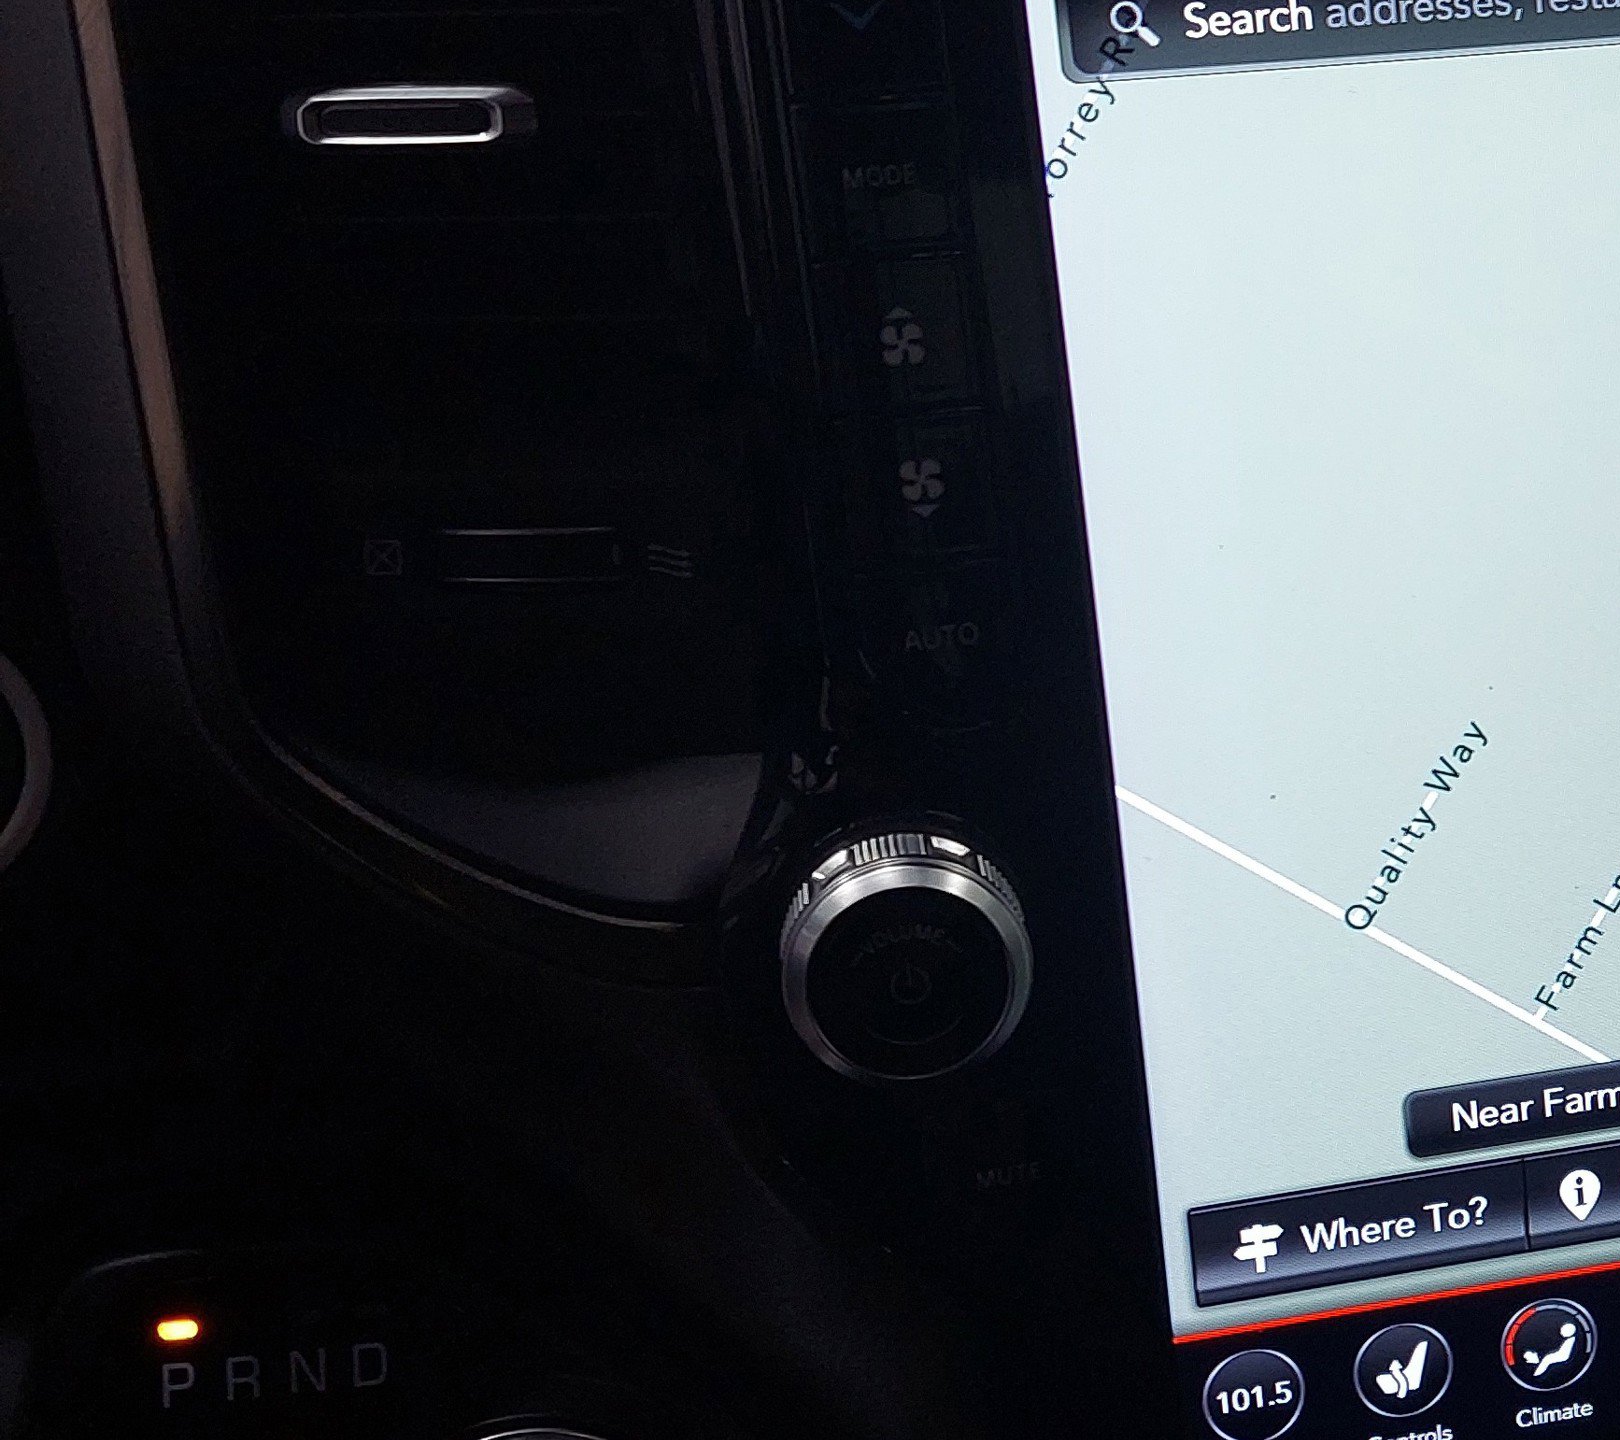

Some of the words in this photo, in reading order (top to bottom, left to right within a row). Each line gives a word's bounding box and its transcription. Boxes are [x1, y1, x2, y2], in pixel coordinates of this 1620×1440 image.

[1047, 77, 1115, 197] orrey
[842, 161, 916, 188] MODE
[904, 621, 979, 651] AUTO
[1343, 806, 1438, 930] Quality
[1423, 721, 1489, 794] Way
[1534, 922, 1604, 1011] Farm
[1451, 1091, 1535, 1132] Near
[1301, 1215, 1417, 1254] Where
[1423, 1196, 1489, 1231] To?
[161, 1359, 196, 1410] P
[225, 1354, 262, 1402] R
[288, 1346, 327, 1394] N
[351, 1341, 388, 1388] D
[1216, 1379, 1293, 1415] 101.5
[1515, 1398, 1594, 1428] Climate
